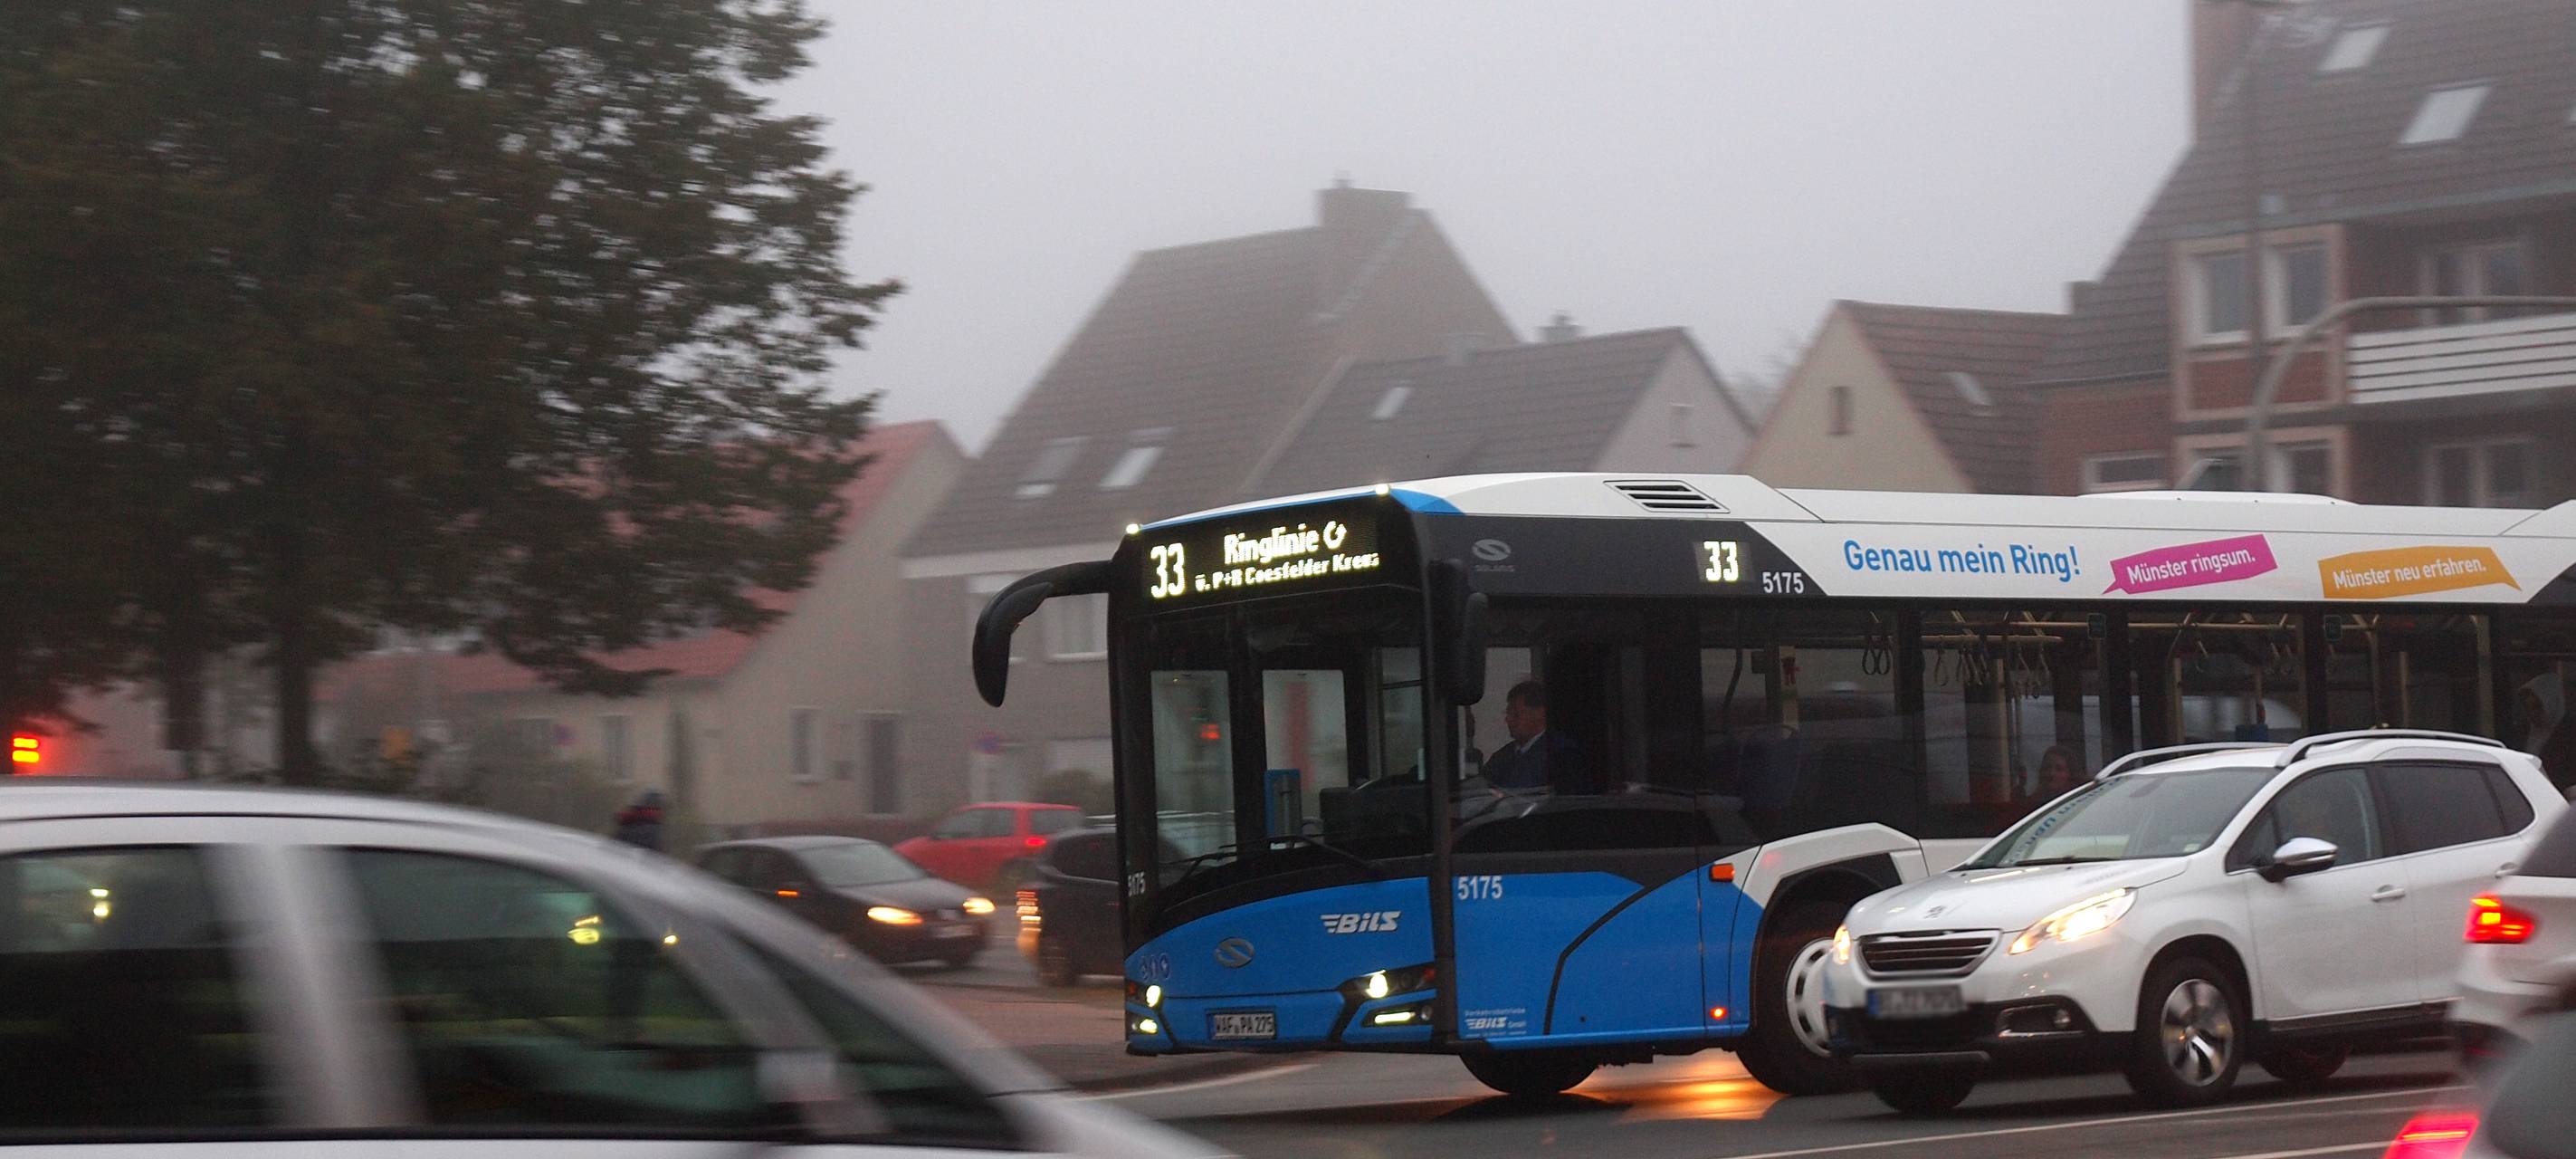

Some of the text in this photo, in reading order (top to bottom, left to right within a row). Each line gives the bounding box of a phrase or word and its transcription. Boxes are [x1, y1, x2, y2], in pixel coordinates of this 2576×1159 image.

[1224, 523, 1320, 564] Ringlinie
[1703, 541, 1739, 582] 33
[1844, 541, 2081, 582] Genau mein Ring!
[1150, 542, 1186, 599] 33
[1245, 558, 1331, 585] Coesfelder
[1762, 570, 1804, 595] 5175
[2127, 547, 2256, 585] Münster ringsum.
[2333, 554, 2487, 590] Münster neu erfahren.
[1457, 876, 1503, 901] 5175
